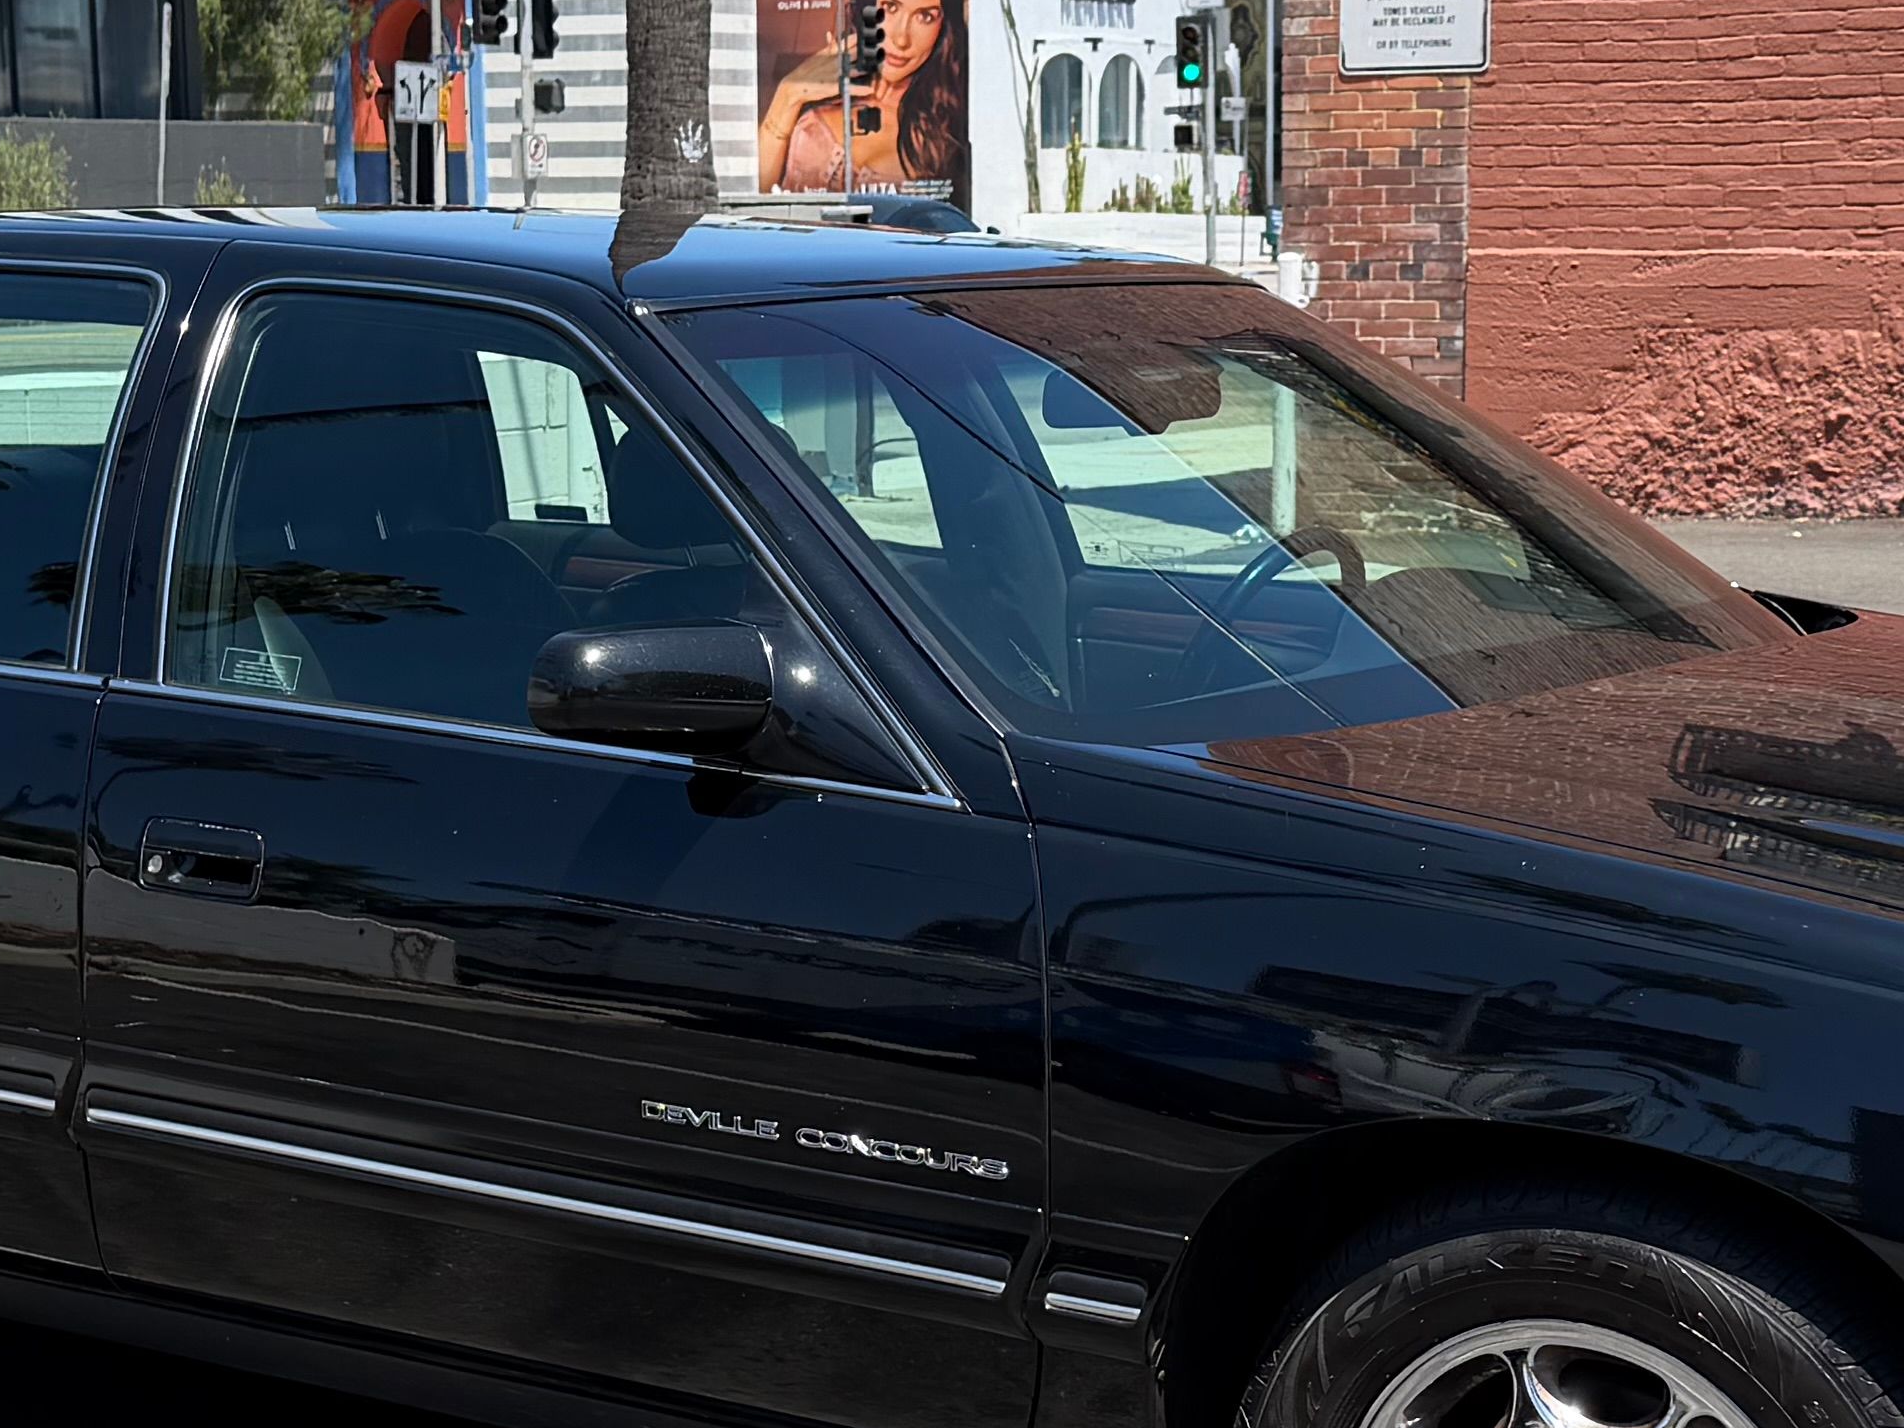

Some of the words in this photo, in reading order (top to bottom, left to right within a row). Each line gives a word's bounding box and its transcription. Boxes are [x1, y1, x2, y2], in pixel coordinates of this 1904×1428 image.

[1383, 6, 1407, 16] TOWED
[1410, 5, 1445, 15] VEHICLES
[1372, 17, 1388, 26] MAY
[1447, 15, 1456, 24] AT
[1401, 38, 1452, 49] TELEPHONING
[641, 1099, 779, 1140] DEVILLE
[795, 1127, 1009, 1181] CONCOURS
